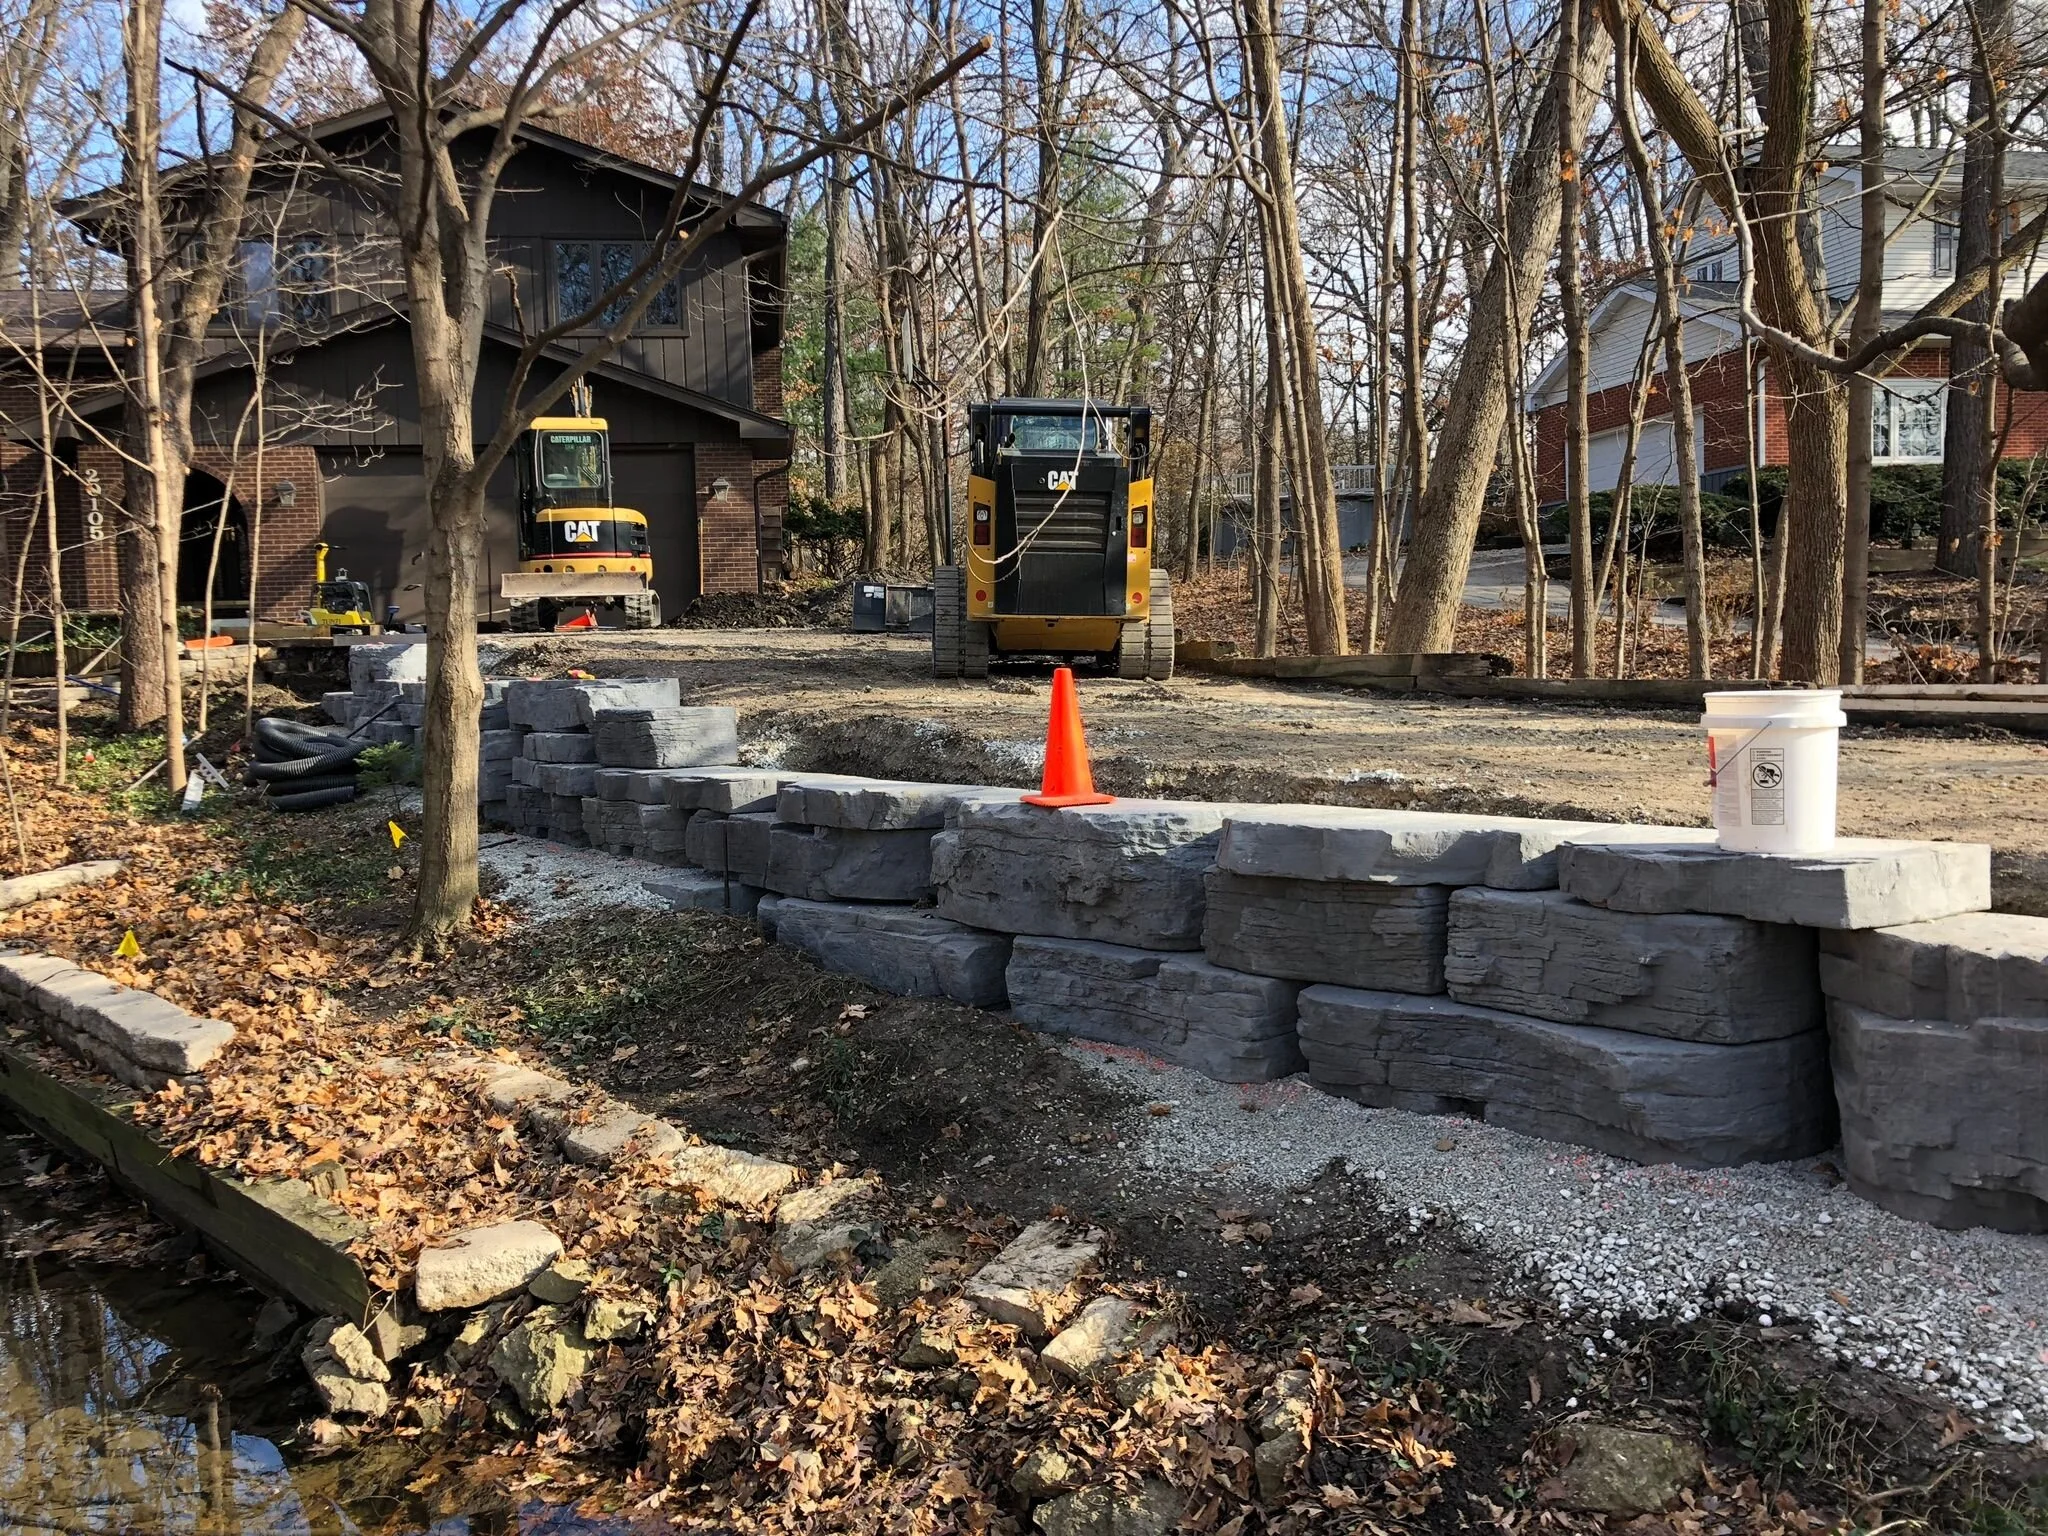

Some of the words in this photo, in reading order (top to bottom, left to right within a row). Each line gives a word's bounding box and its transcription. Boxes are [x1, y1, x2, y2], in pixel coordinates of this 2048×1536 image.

[550, 435, 592, 444] CATERPILLAR
[1047, 470, 1079, 491] CAT
[564, 521, 601, 543] CAT
